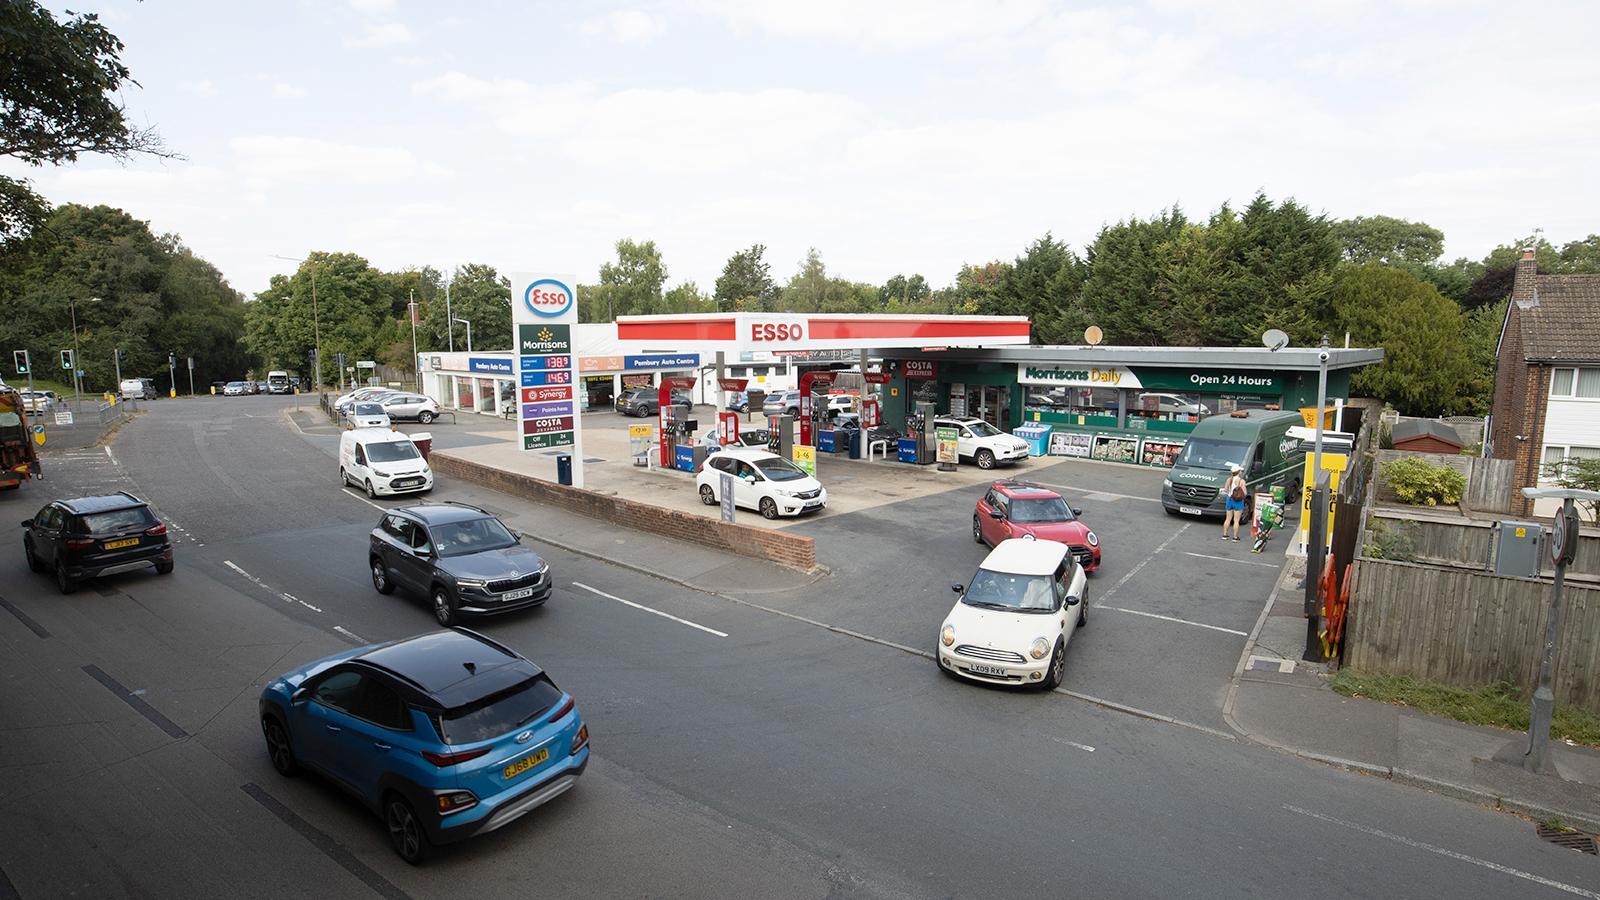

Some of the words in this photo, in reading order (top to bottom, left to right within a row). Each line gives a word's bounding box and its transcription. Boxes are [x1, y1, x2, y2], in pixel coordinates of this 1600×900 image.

[533, 289, 566, 305] Esso
[752, 323, 803, 341] ESSO
[523, 340, 568, 349] Morrisons
[547, 357, 568, 368] 138.9
[634, 359, 660, 367] Pembury
[906, 361, 932, 370] COSTA
[548, 372, 569, 383] 146.9
[1025, 366, 1089, 381] Morrisons
[1091, 368, 1121, 385] Daily
[1190, 374, 1219, 386] Open
[1222, 375, 1235, 384] 24
[1238, 375, 1272, 386] Hours
[539, 390, 567, 400] Synergy
[536, 418, 562, 427] COSTA
[1179, 472, 1218, 482] CONWAY
[970, 664, 990, 673] LX09
[990, 667, 1005, 675] RXV
